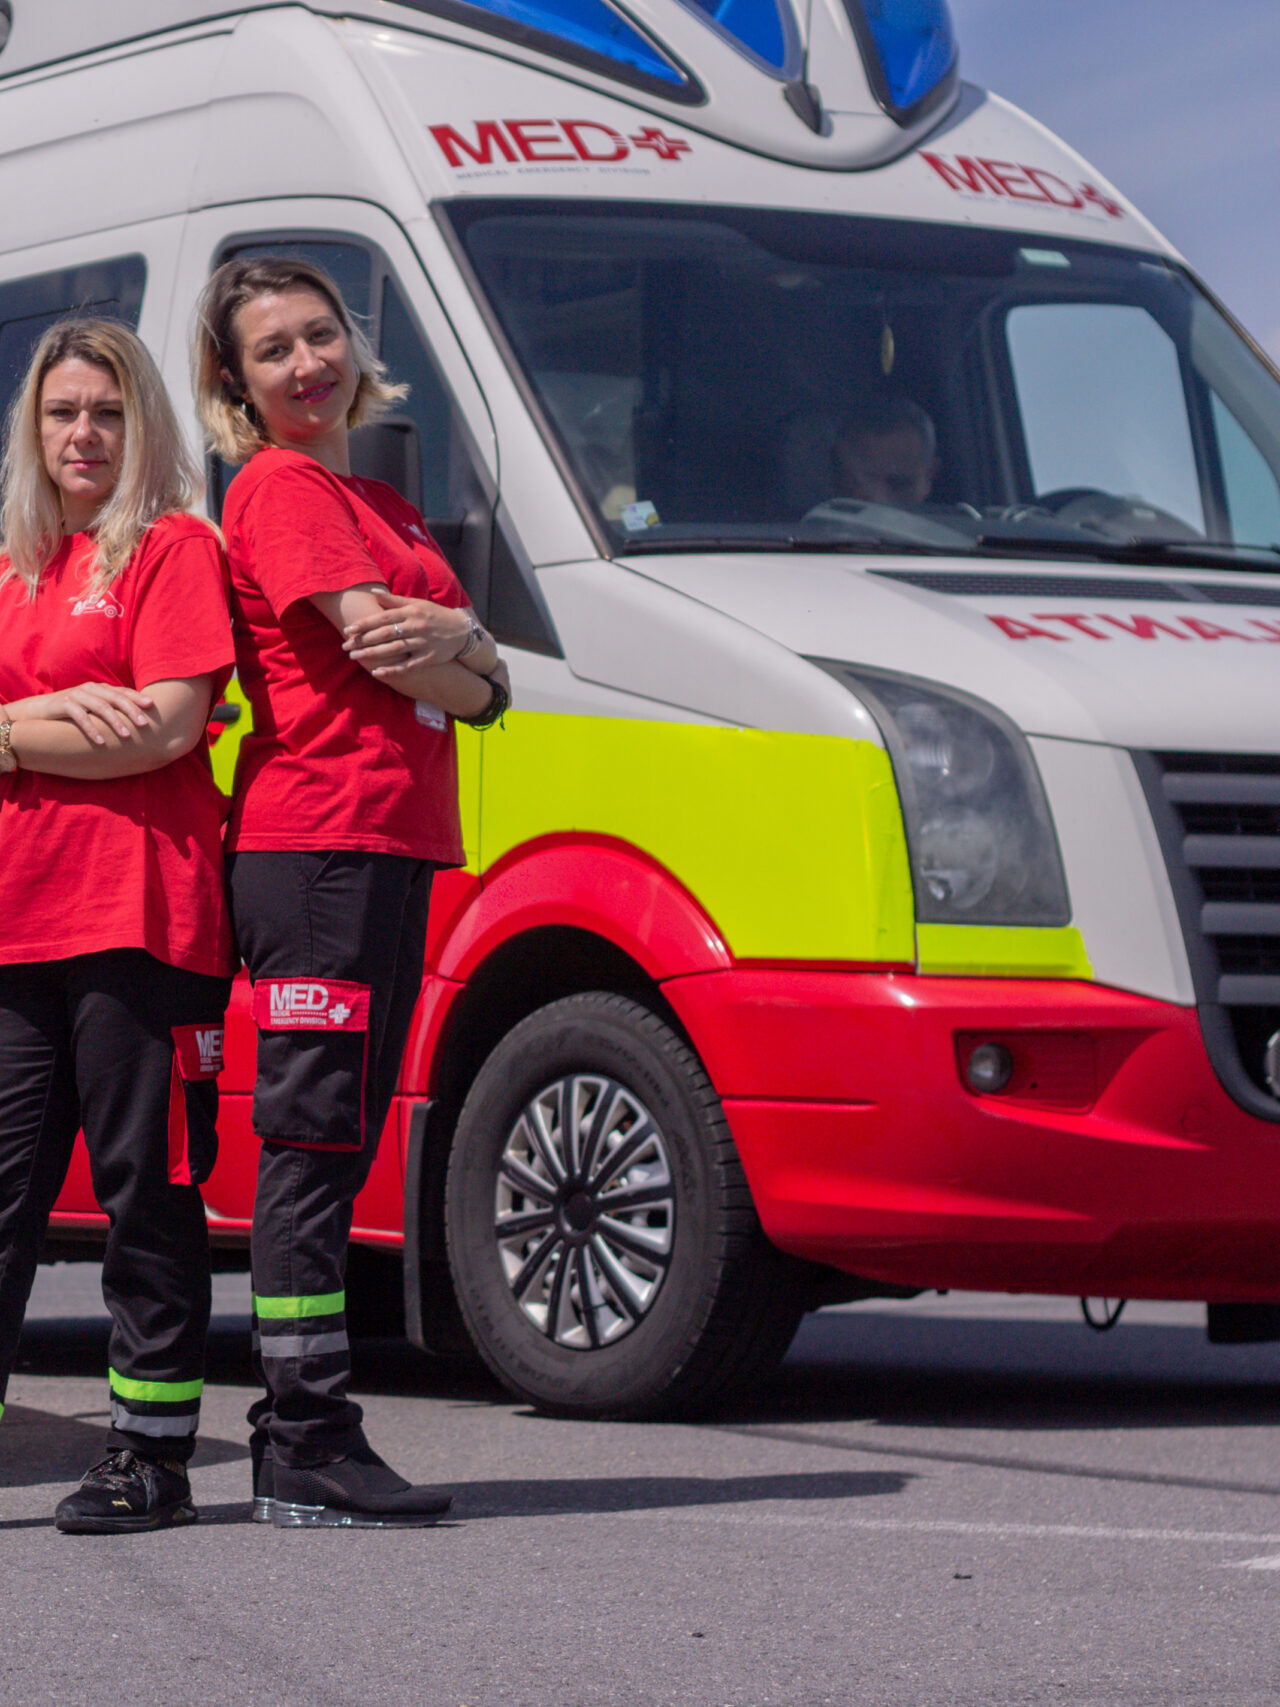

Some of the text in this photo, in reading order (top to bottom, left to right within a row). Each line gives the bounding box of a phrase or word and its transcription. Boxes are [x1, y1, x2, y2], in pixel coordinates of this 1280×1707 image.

[428, 119, 630, 168] MED
[918, 150, 1085, 209] MED
[269, 983, 329, 1011] MED
[195, 1029, 225, 1057] ME
